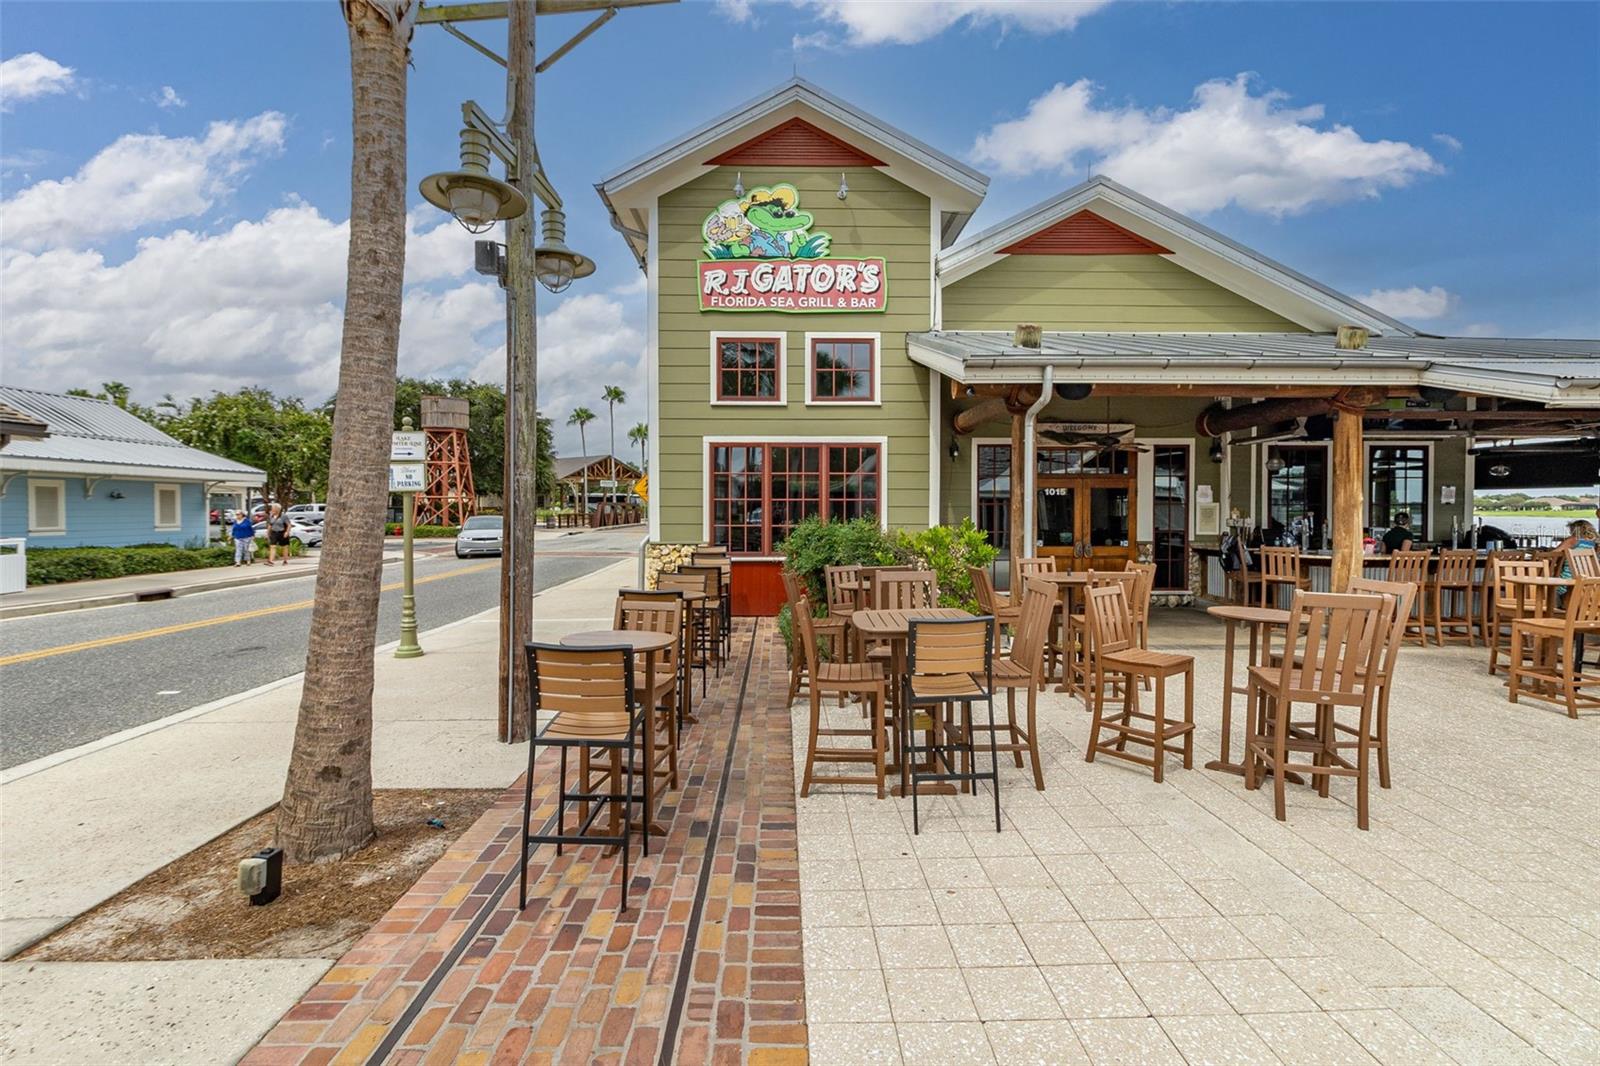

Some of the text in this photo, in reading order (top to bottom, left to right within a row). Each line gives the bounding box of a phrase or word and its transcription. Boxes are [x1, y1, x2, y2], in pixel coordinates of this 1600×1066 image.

[750, 262, 880, 293] GATOR'S
[710, 297, 876, 308] FLORIDA SEA GRILL & BAR
[1044, 488, 1066, 496] 1015
